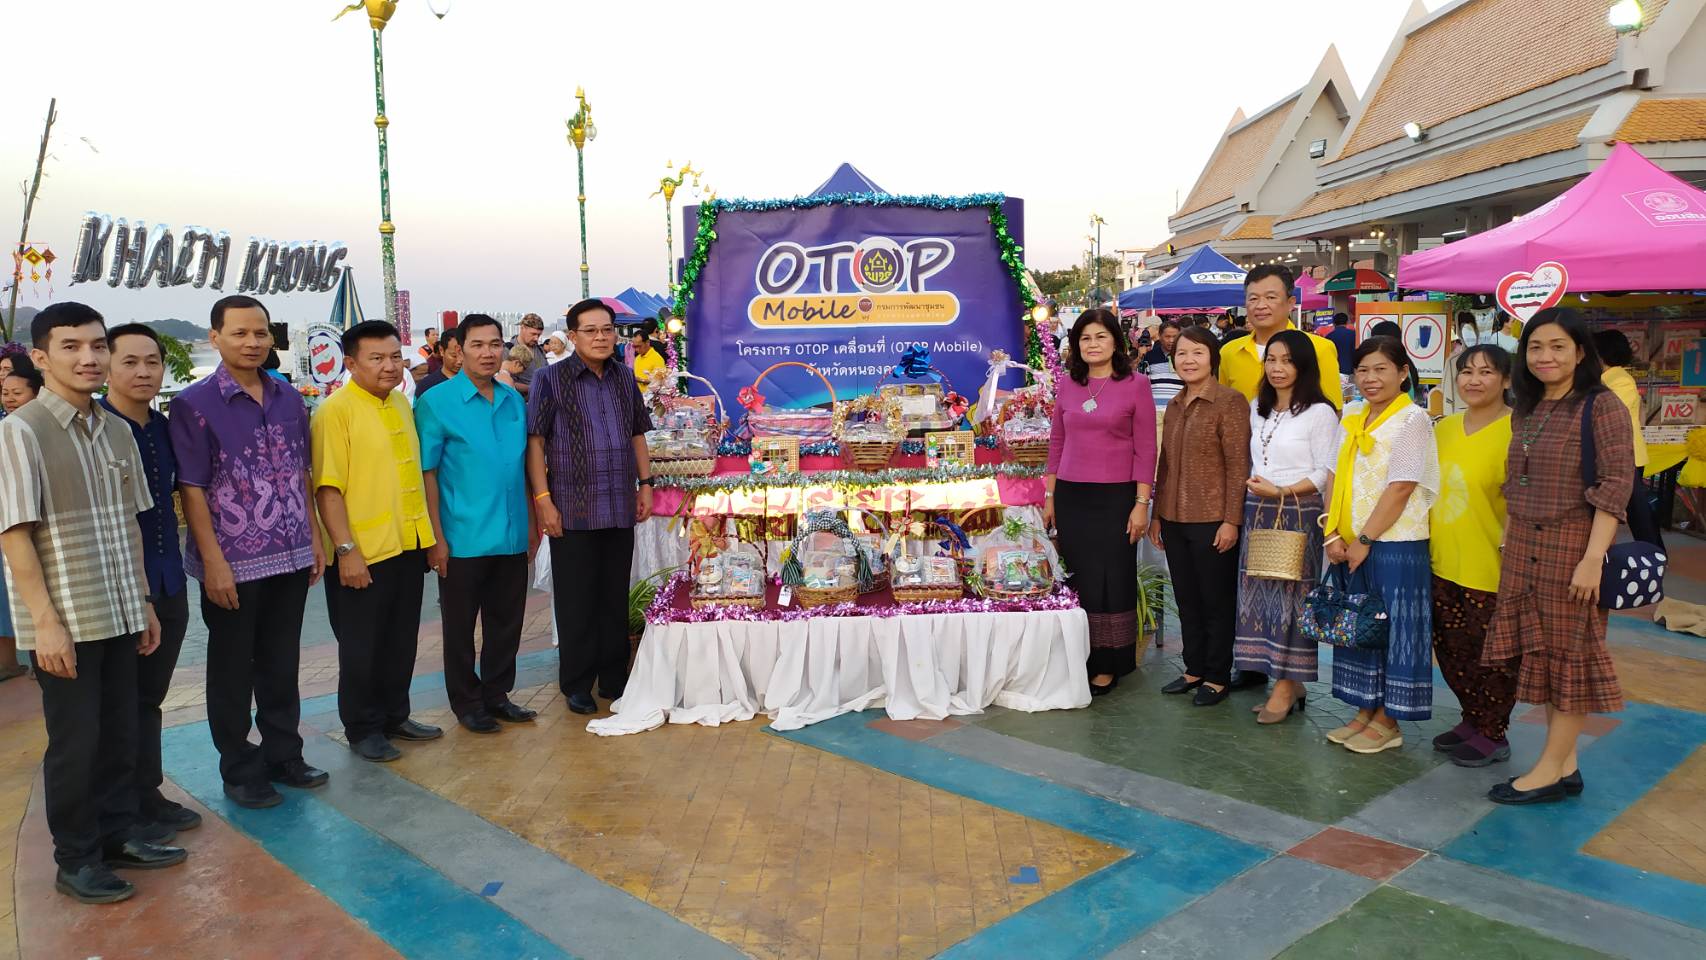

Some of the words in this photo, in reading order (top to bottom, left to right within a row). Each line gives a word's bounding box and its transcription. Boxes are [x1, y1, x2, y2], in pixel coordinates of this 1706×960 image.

[235, 235, 348, 295] KHONG
[757, 238, 953, 294] OTOP
[763, 299, 857, 322] Mobile
[736, 339, 791, 356] โครงการ
[795, 343, 829, 355] OTOP
[834, 336, 886, 354] เคลื่อนที่
[933, 340, 983, 354] Mobile)
[806, 361, 904, 376] จังหวัดหนองค
